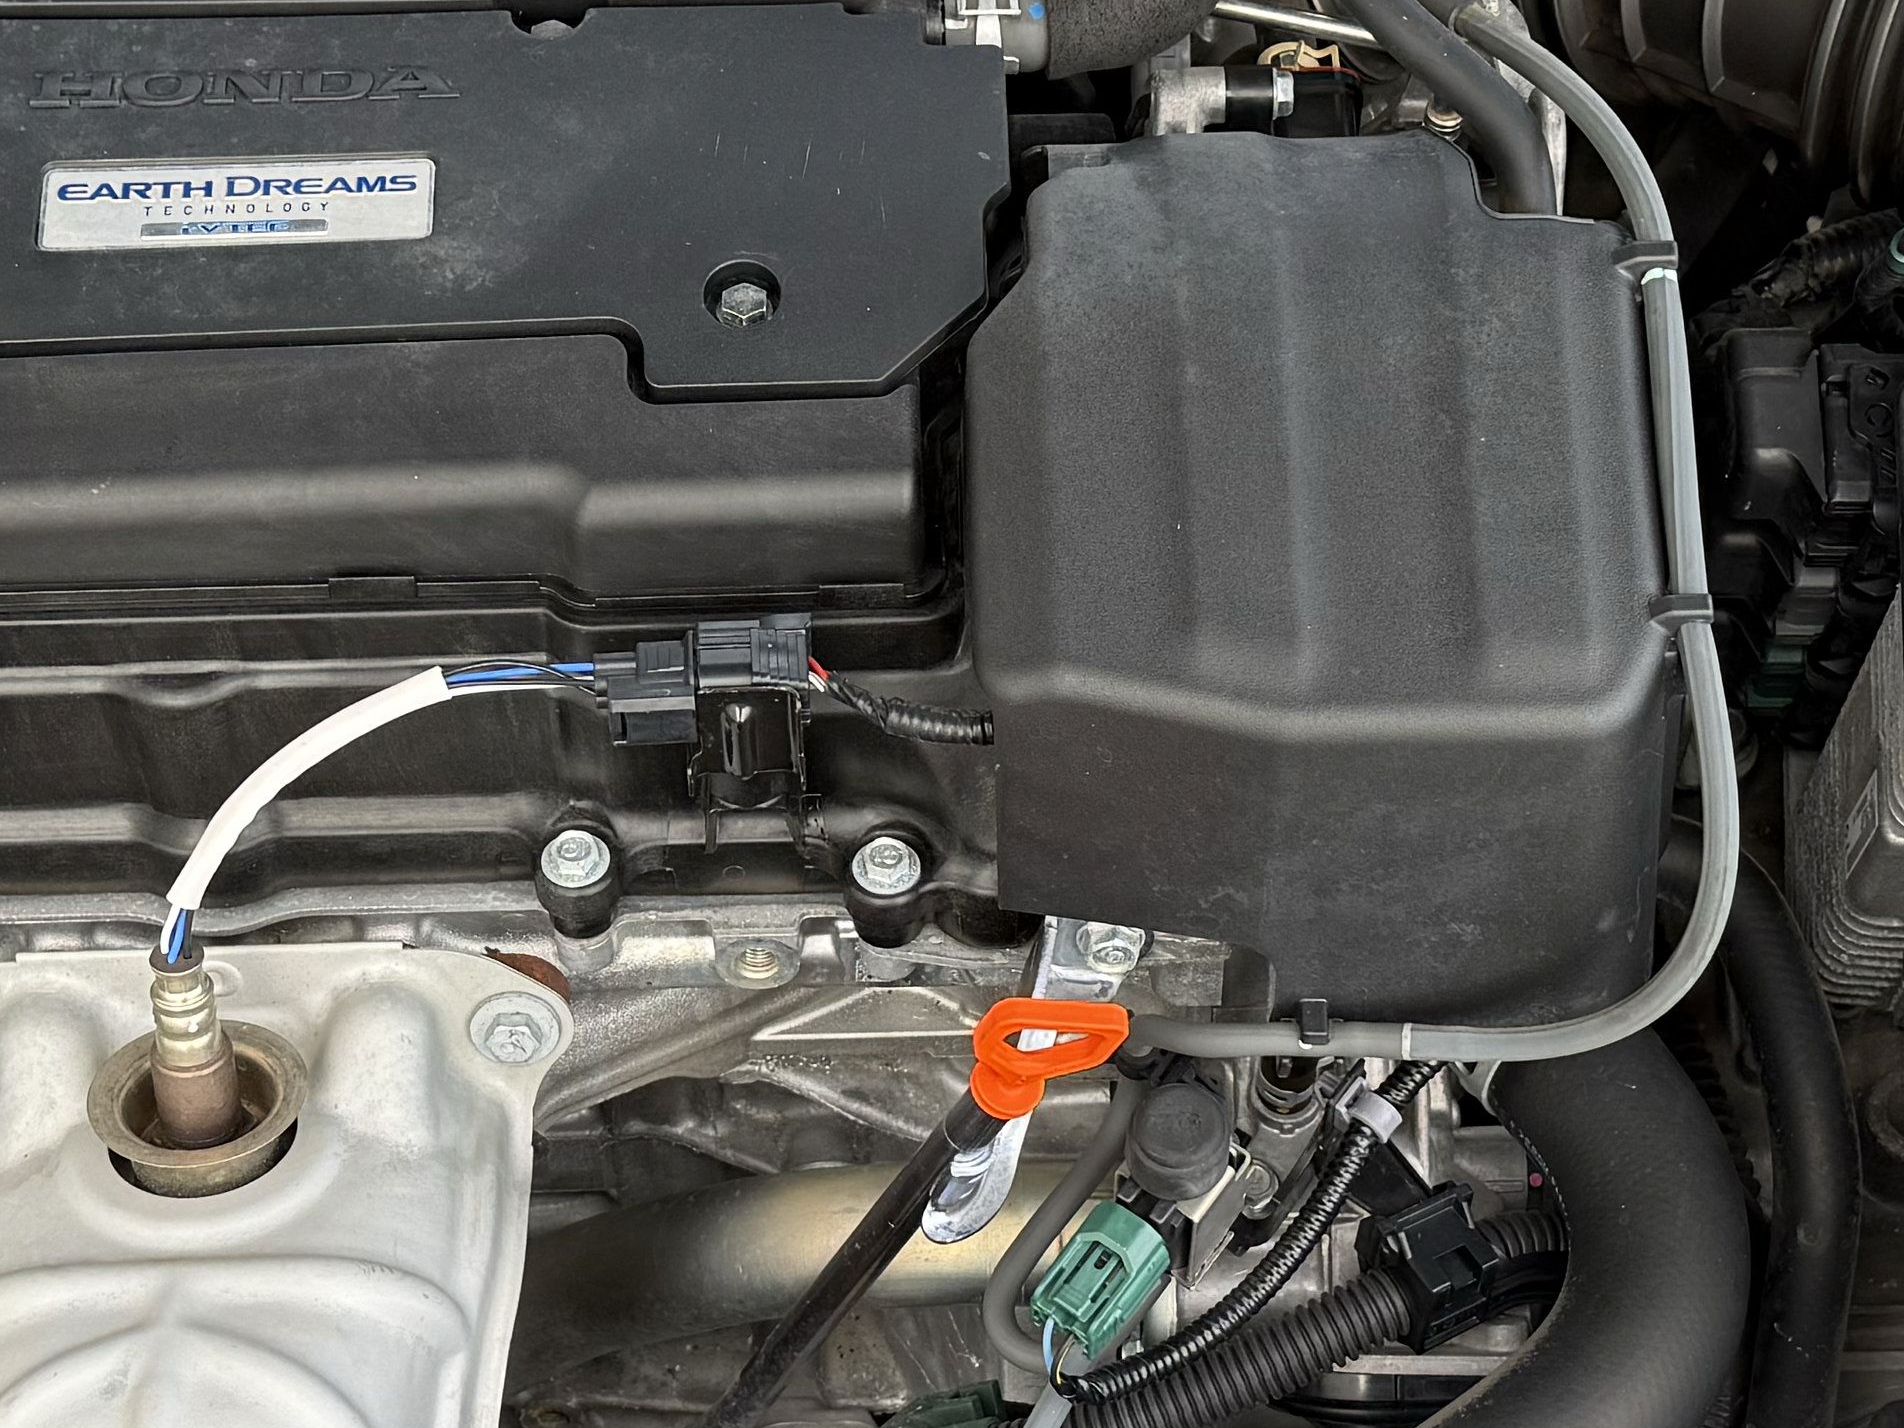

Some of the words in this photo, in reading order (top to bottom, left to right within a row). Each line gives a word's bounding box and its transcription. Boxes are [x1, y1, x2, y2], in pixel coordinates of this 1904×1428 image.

[28, 64, 460, 110] HONDA
[56, 180, 214, 202] EARTH
[224, 174, 418, 198] DREAMS
[142, 200, 330, 218] TECHNOLOGY
